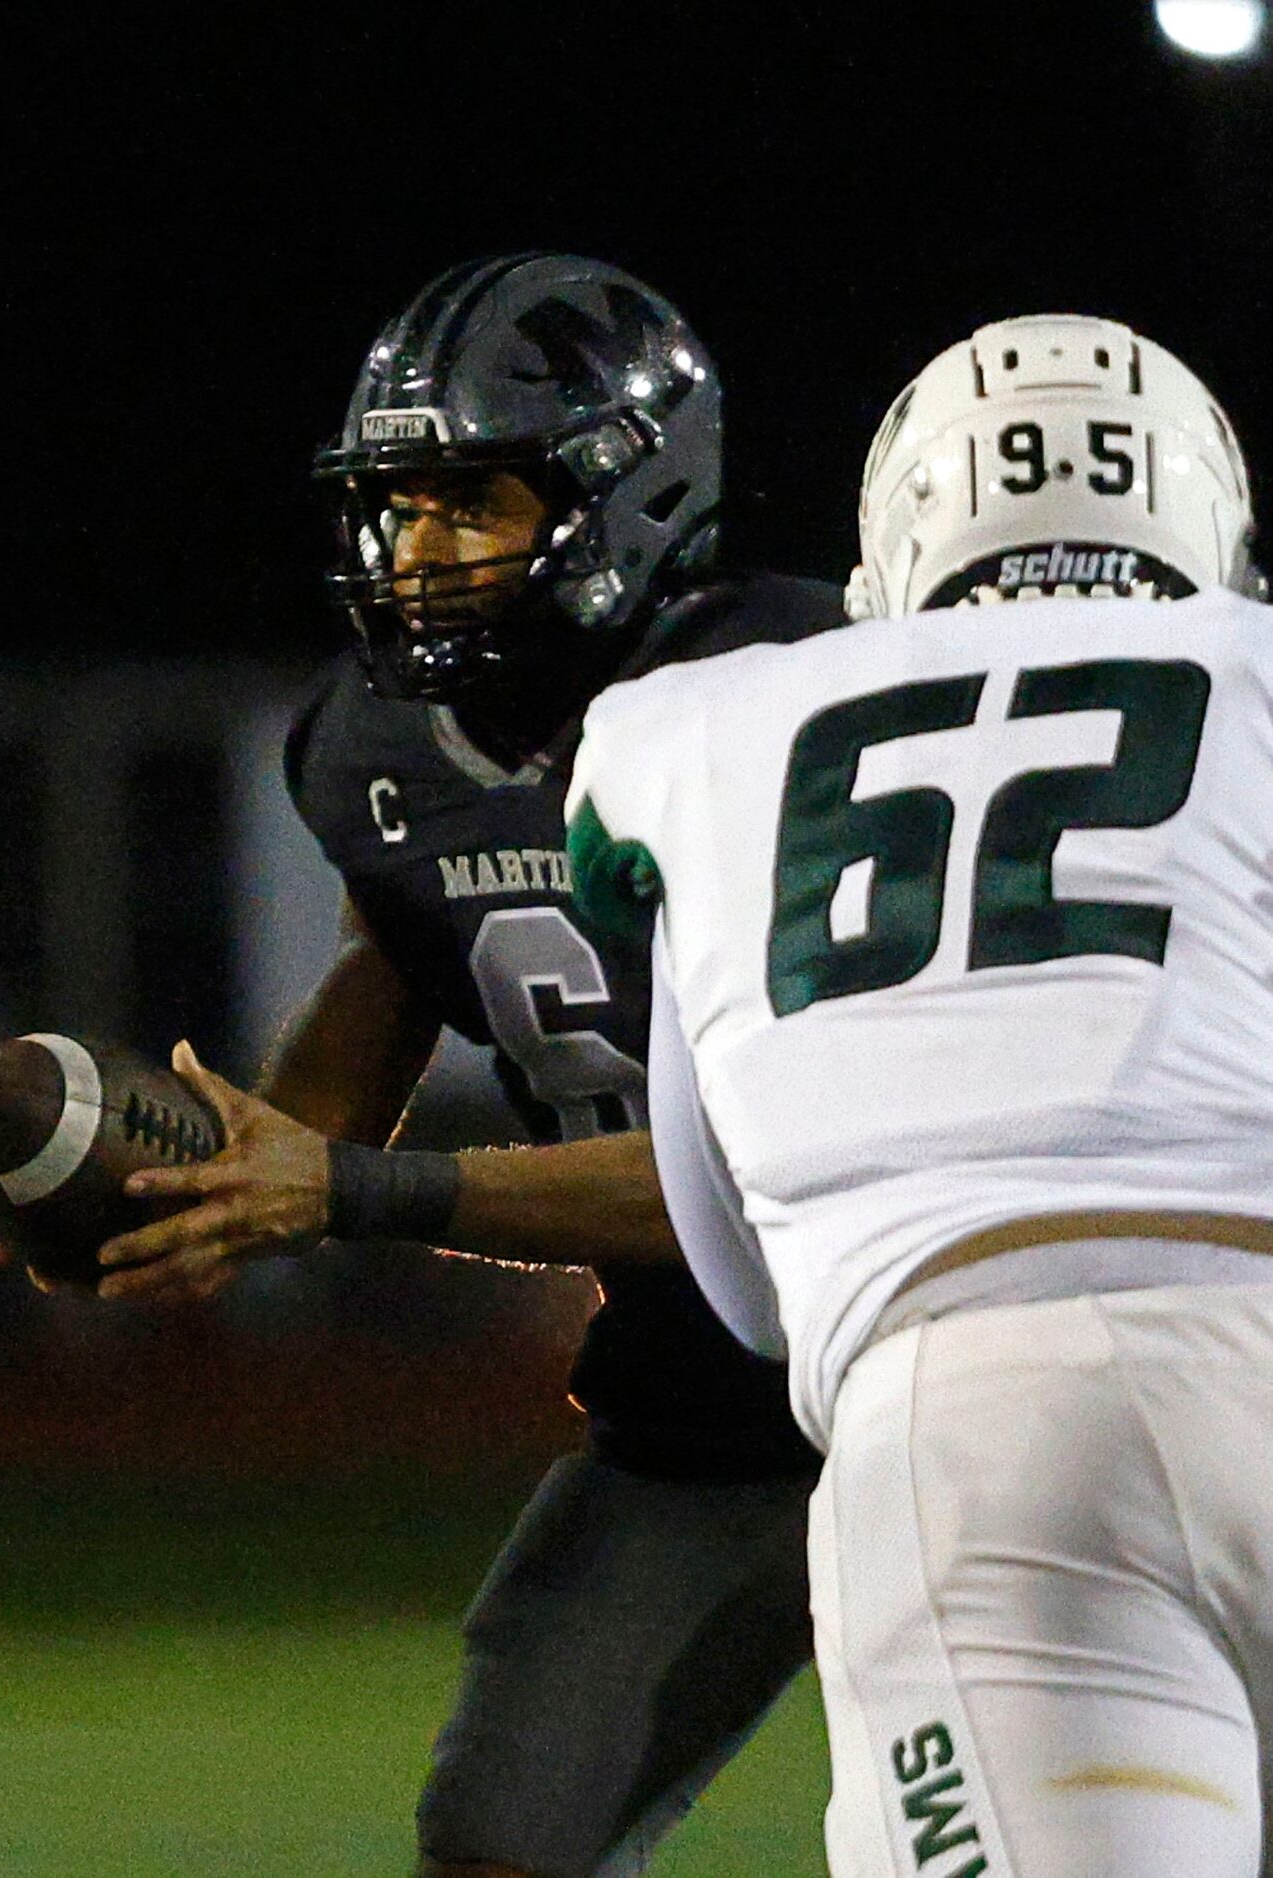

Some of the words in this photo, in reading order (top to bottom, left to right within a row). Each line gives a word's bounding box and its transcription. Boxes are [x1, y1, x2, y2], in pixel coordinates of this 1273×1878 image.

[361, 416, 427, 440] MARTIN
[998, 541, 1141, 585] schutt
[368, 777, 408, 843] C
[766, 657, 1211, 1018] 62
[469, 906, 649, 1144] 6
